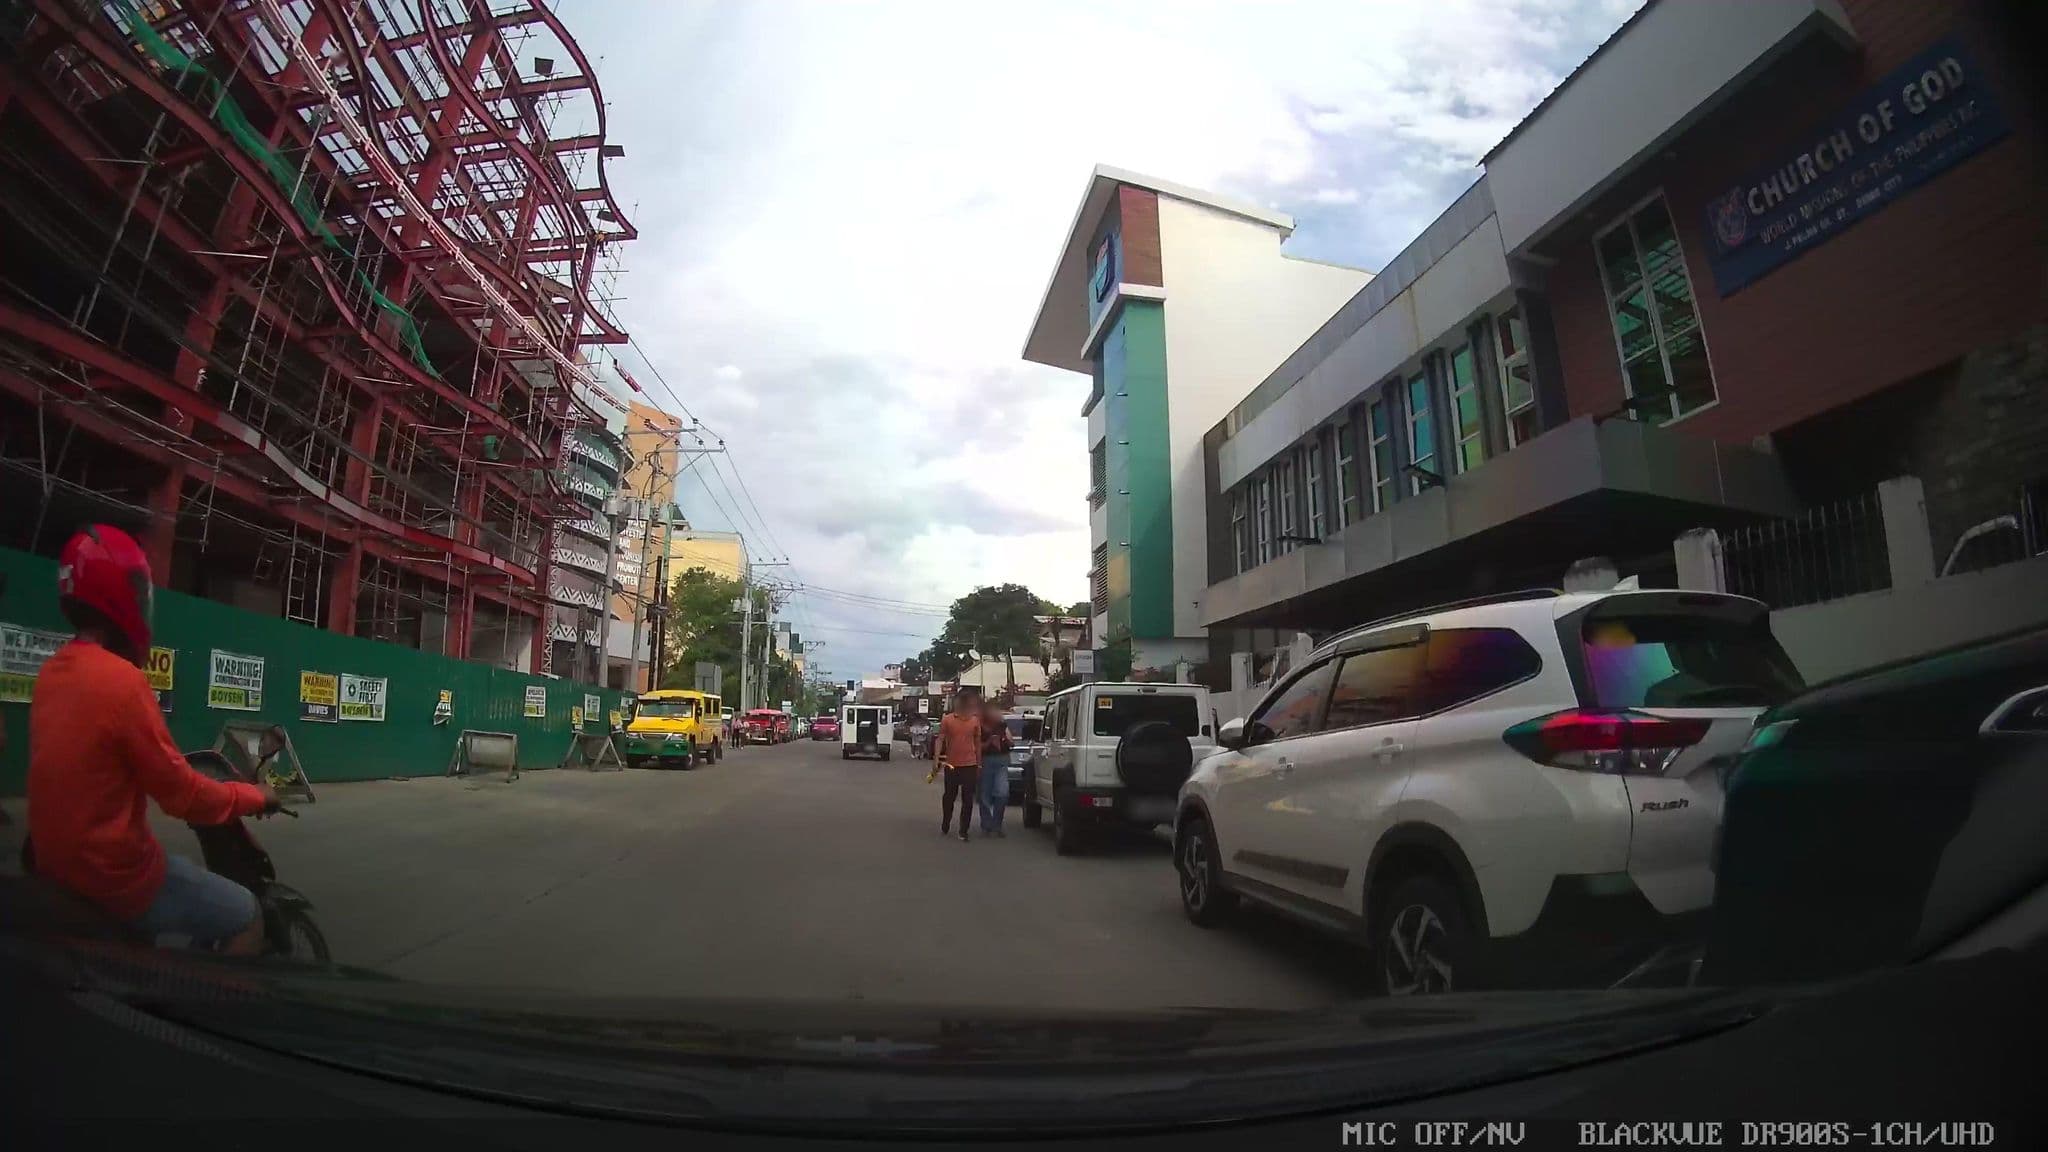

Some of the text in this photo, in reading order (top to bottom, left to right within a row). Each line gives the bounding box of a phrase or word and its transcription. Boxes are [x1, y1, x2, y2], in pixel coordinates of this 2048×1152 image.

[1747, 129, 1854, 216] CHURCH
[1857, 98, 1896, 144] OF
[1902, 57, 1965, 115] GOD
[215, 656, 262, 679] WARNING!
[211, 689, 244, 705] BOYSEN
